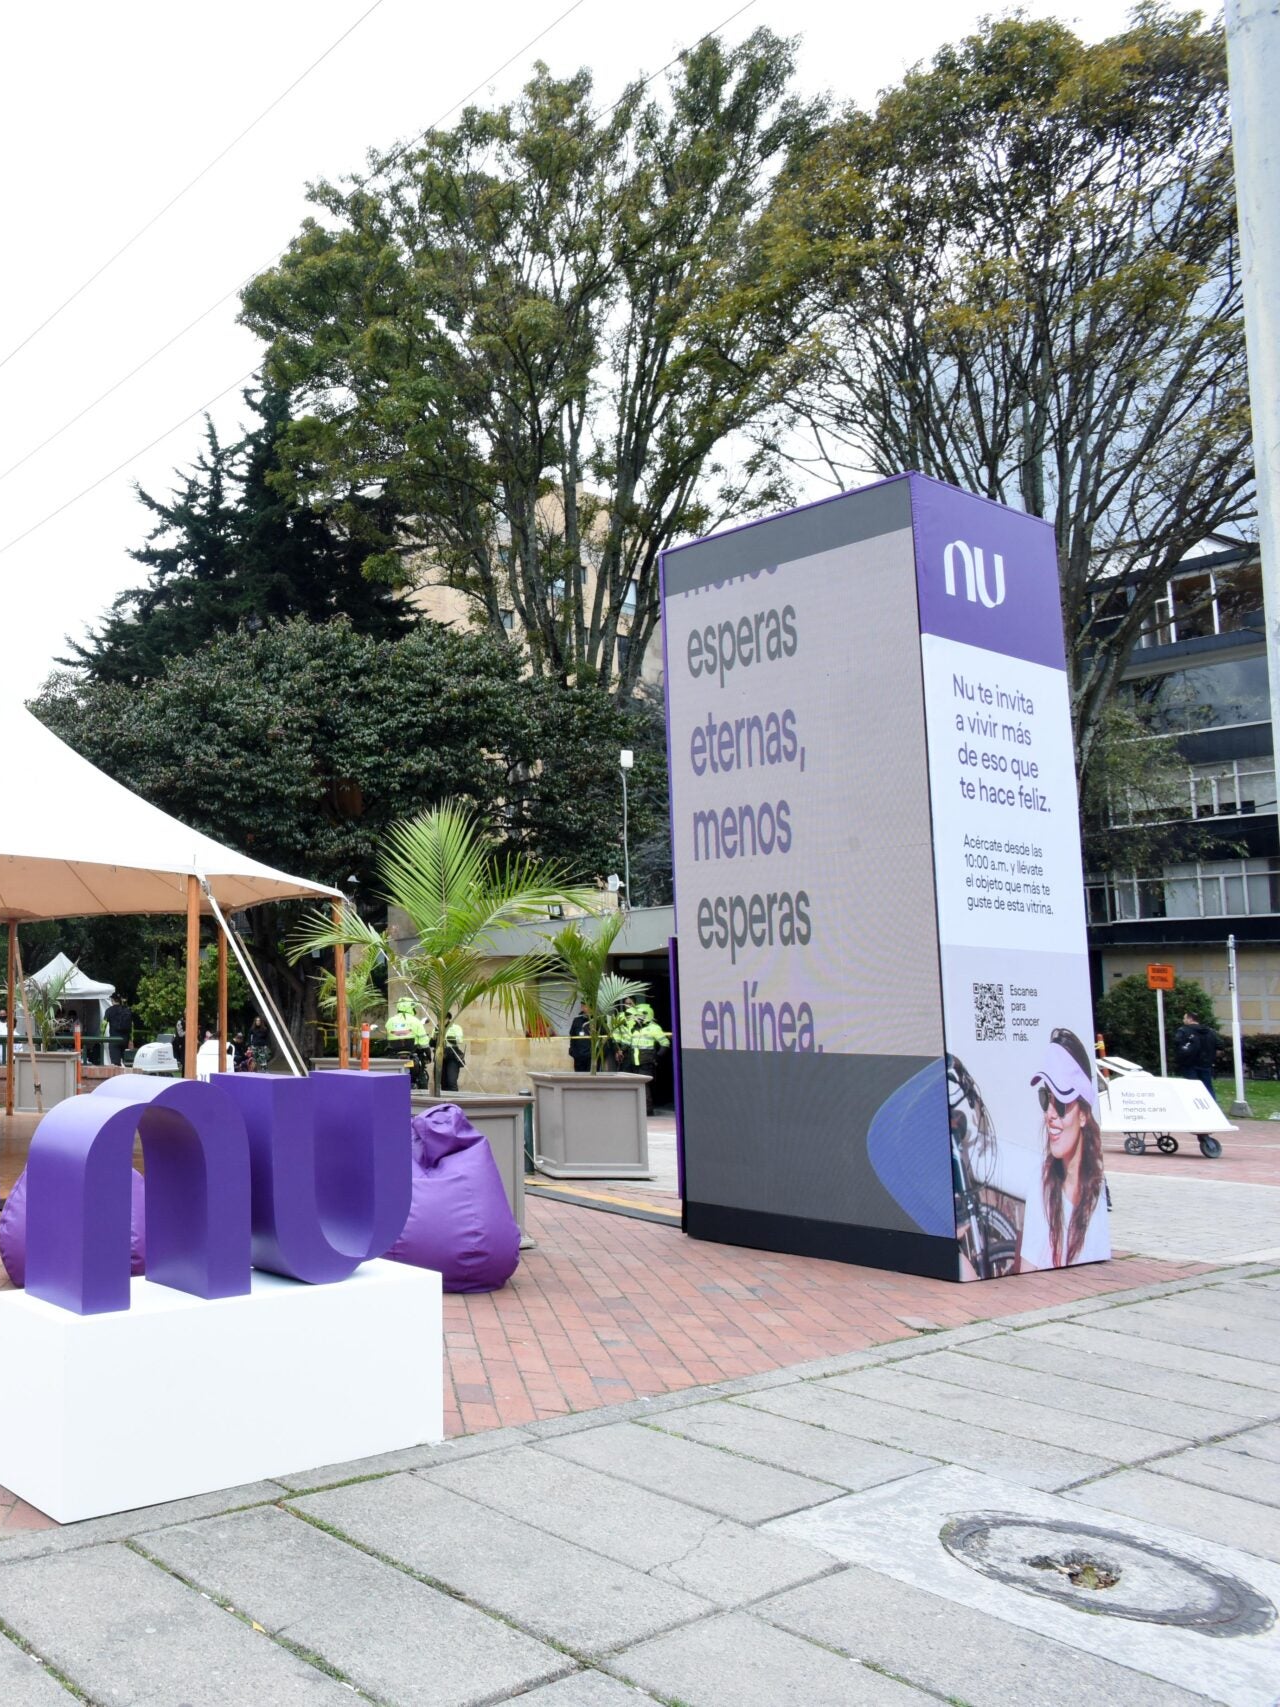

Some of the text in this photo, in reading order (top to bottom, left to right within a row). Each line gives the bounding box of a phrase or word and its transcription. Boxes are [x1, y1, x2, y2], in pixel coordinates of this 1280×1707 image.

[687, 604, 798, 688] esperas
[952, 672, 1034, 715] Nu te invita
[690, 708, 806, 776] eternas,
[955, 711, 1032, 746] a vivir más
[958, 741, 1039, 781] de eso que
[959, 776, 1051, 812] te hace feliz.
[693, 800, 792, 861] menos
[963, 833, 1043, 858] Acércate desde las
[964, 853, 1044, 876] 10:00 a.m. y llévate
[965, 873, 1051, 896] el objeto que más te
[966, 896, 1054, 915] guste de esta vitrina.
[697, 890, 812, 965] esperas
[1009, 984, 1038, 997] Escanea
[1010, 1002, 1027, 1013] para
[701, 980, 824, 1053] en línea.
[1011, 1017, 1040, 1027] conocer
[1012, 1030, 1030, 1042] más.
